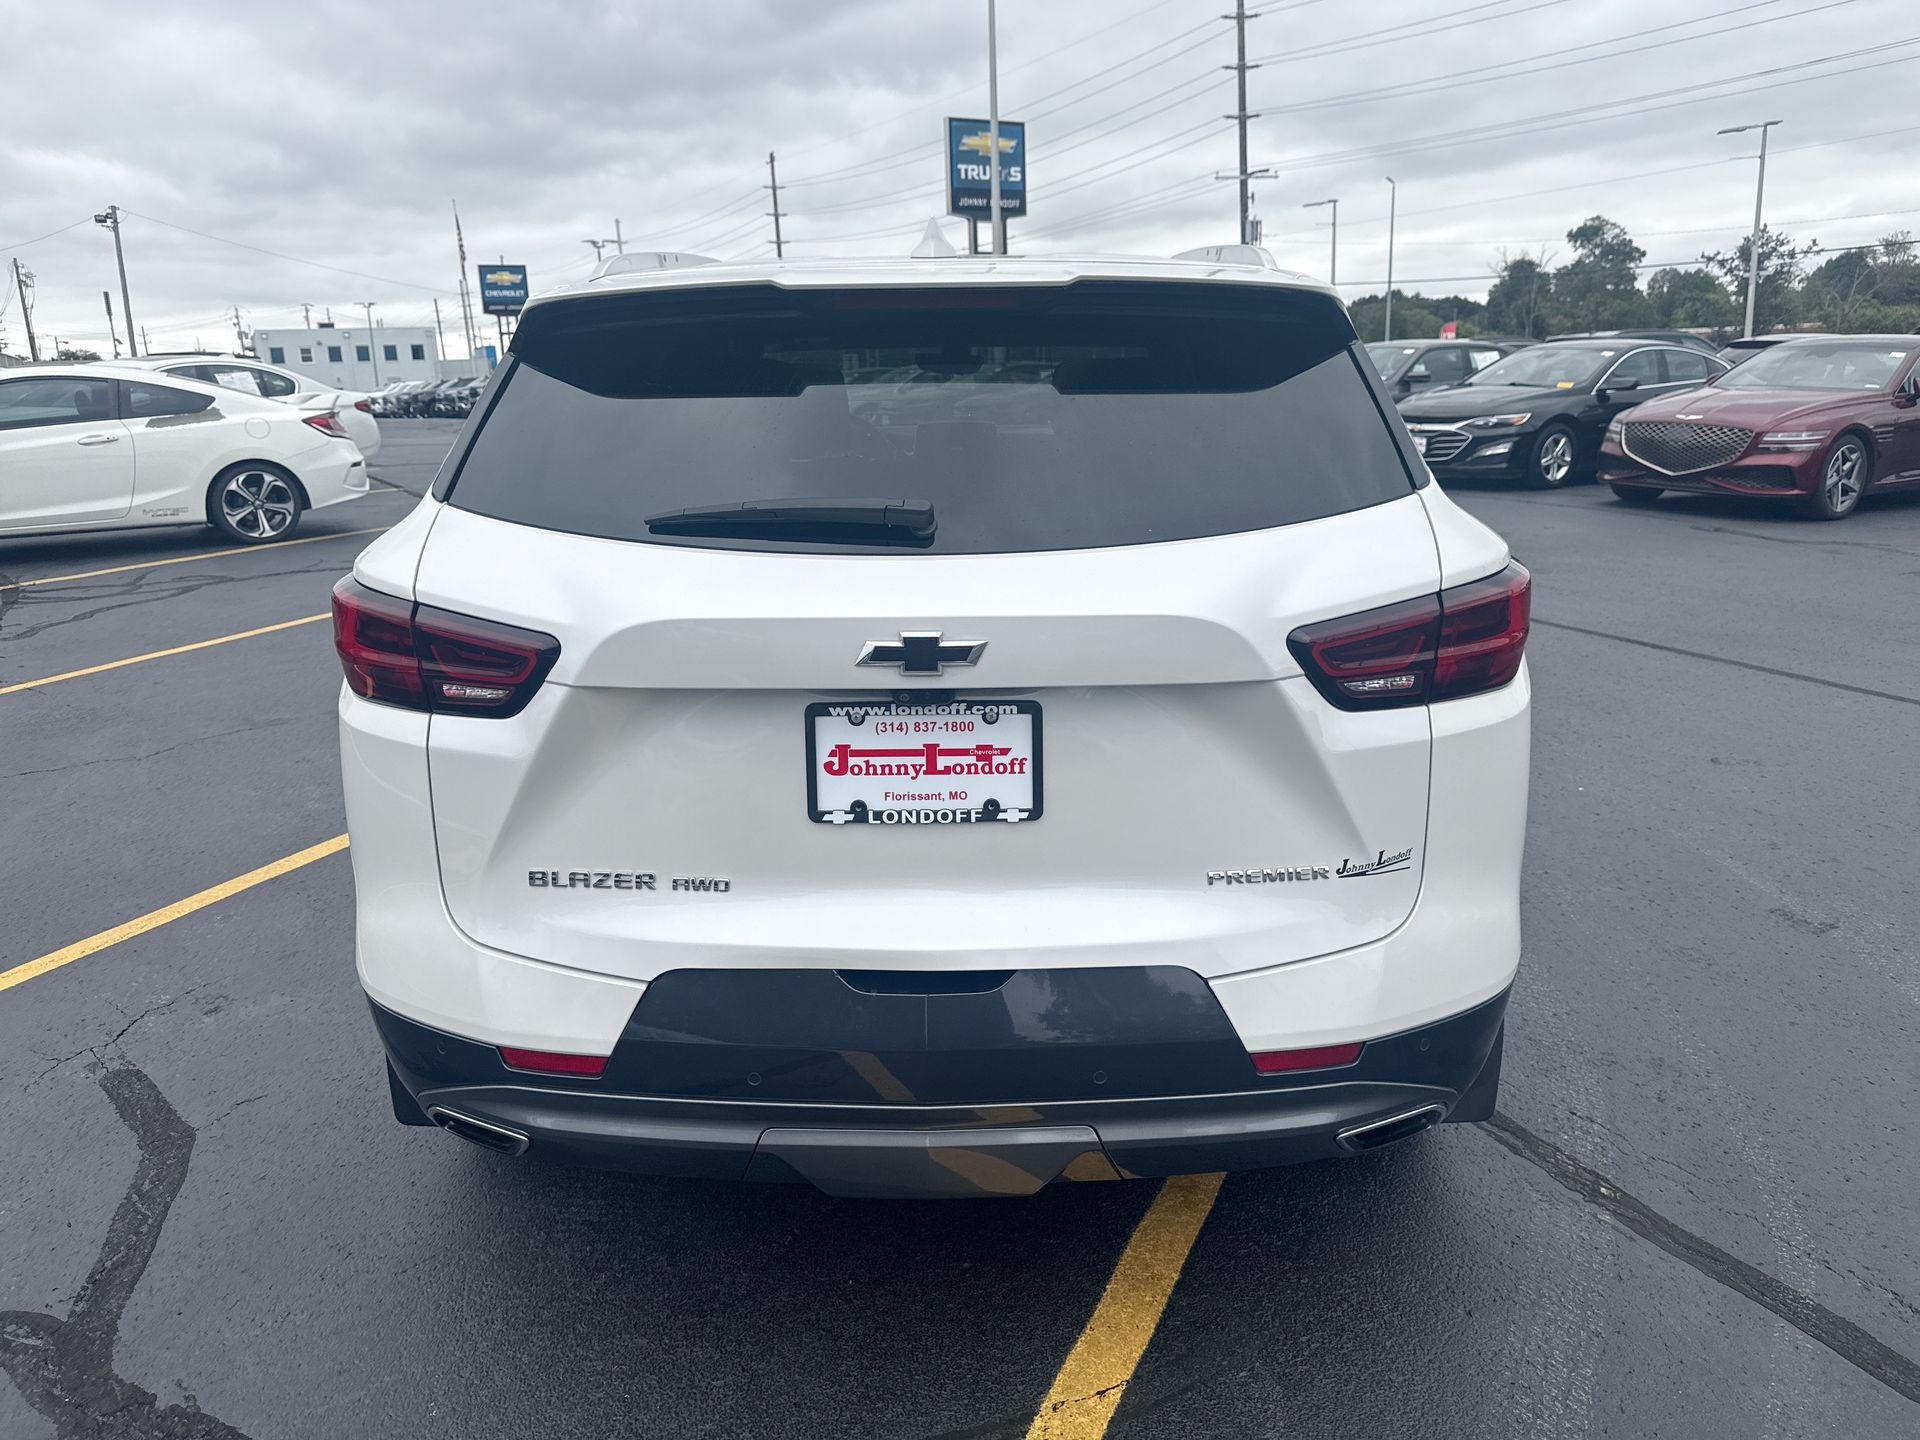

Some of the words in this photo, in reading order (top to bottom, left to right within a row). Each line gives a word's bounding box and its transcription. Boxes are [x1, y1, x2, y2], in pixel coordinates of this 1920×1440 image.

[957, 164, 1022, 181] TRUKS
[828, 703, 1018, 716] www.londoff.com
[875, 722, 909, 735] (314)
[913, 721, 975, 733] 837-1800
[823, 744, 923, 780] Johnny
[922, 743, 1028, 775] Londoff
[884, 792, 946, 802] Florissant,
[949, 791, 968, 801] MO
[867, 809, 983, 824] LONDOFF
[1335, 858, 1376, 876] Johnny
[1375, 847, 1413, 867] Londoff
[528, 869, 656, 890] BLAZER
[672, 876, 731, 893] AWD
[1207, 865, 1330, 885] PREMIER
